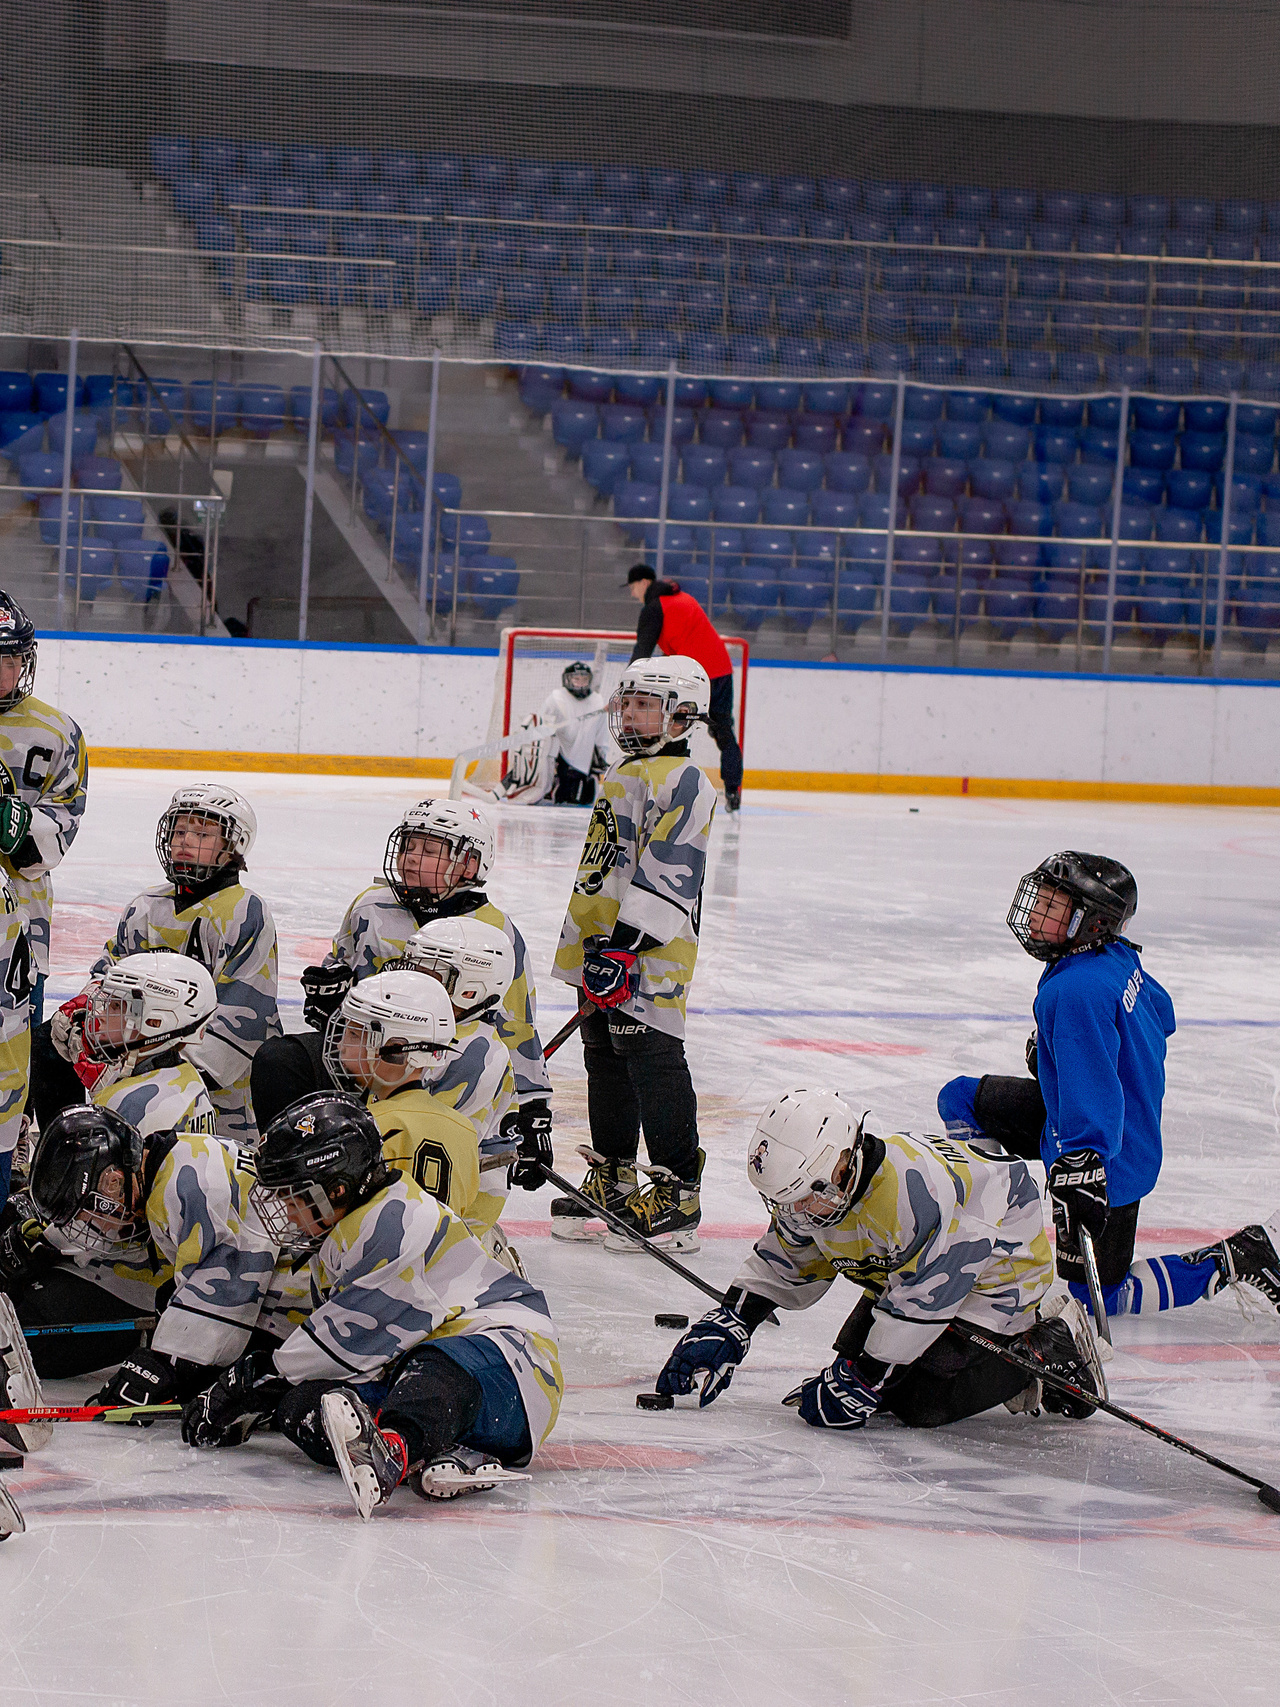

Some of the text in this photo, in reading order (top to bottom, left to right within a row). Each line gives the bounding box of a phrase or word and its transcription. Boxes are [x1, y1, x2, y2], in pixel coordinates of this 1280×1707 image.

[22, 745, 54, 788] C
[464, 956, 492, 967] BAUER
[305, 978, 355, 996] CCM
[183, 987, 199, 1008] 2
[392, 1011, 429, 1023] BAUER
[306, 1150, 340, 1166] BAUER
[969, 1334, 1003, 1355] BAUER
